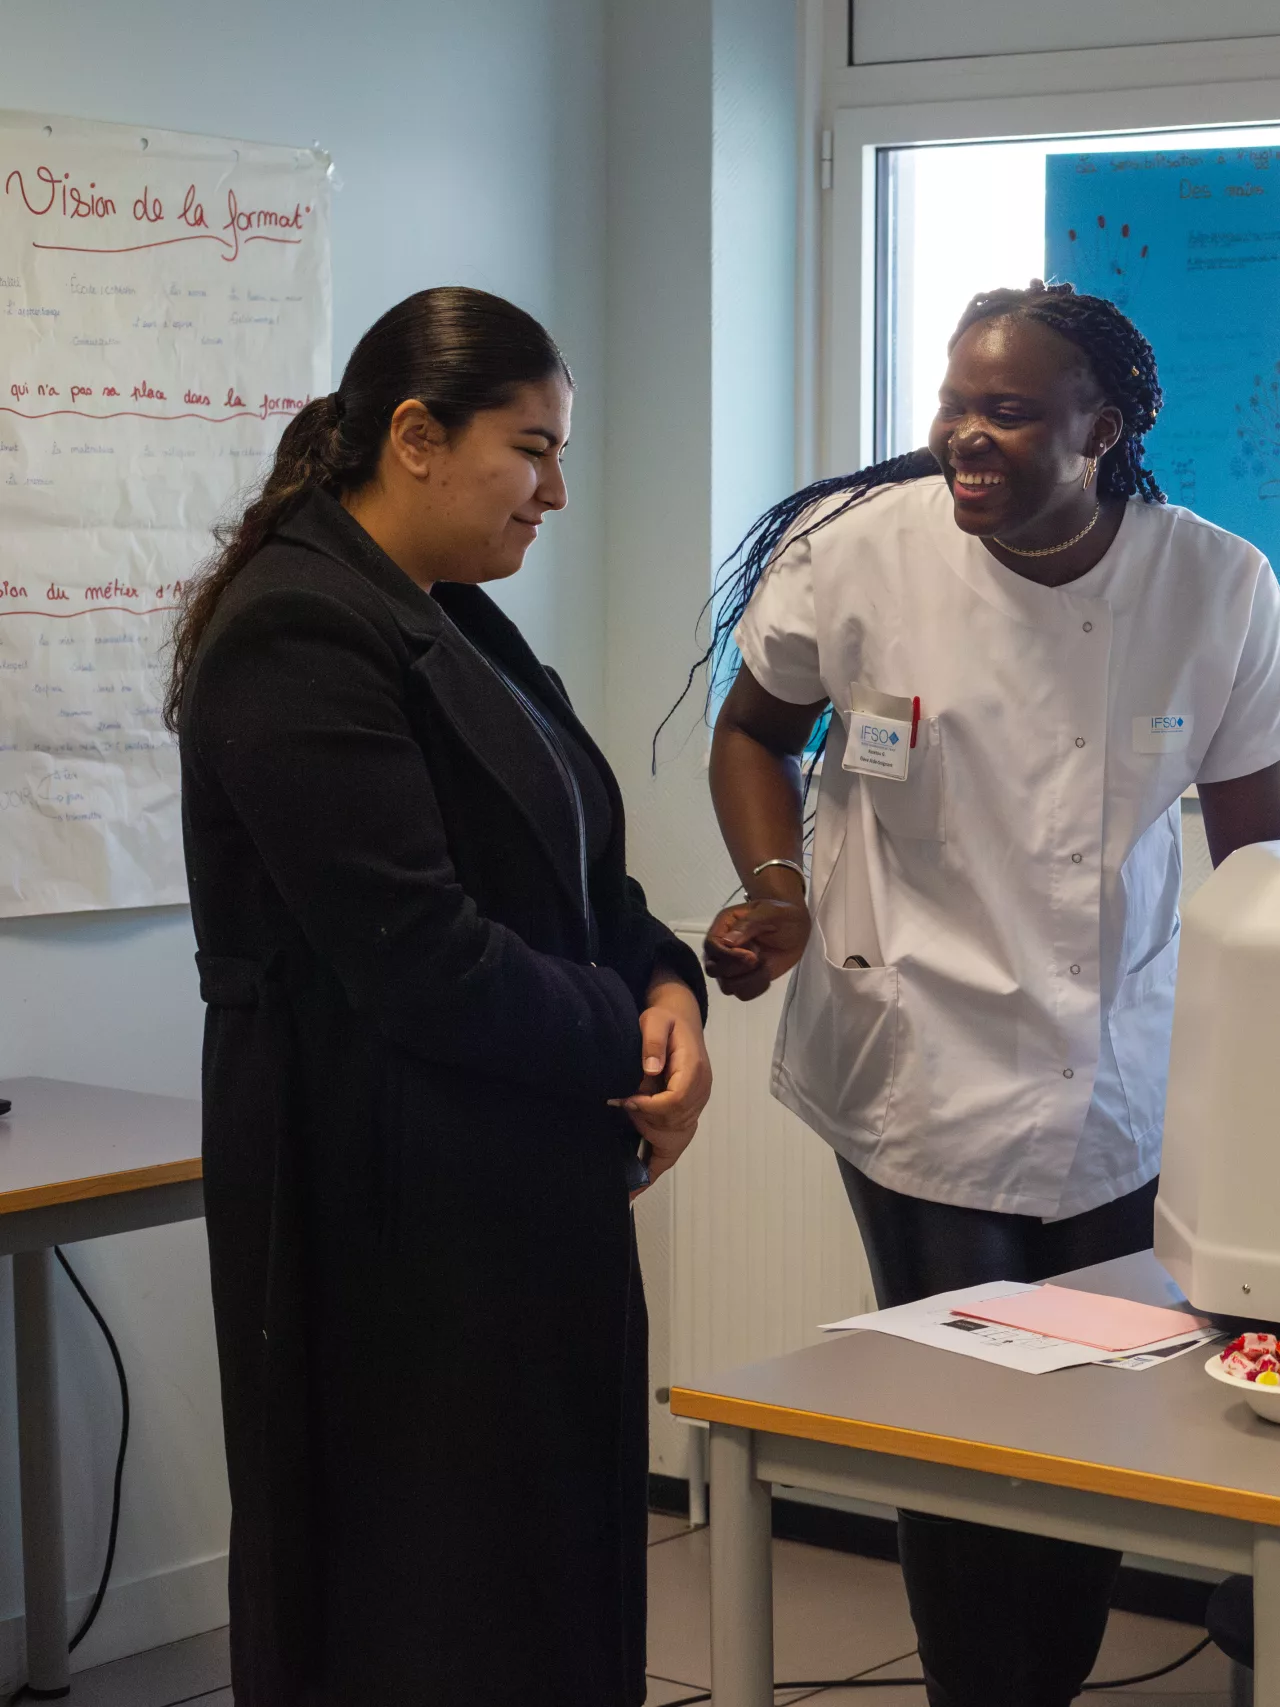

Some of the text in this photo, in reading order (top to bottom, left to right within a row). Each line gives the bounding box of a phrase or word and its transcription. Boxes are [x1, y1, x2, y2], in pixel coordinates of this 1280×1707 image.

[5, 165, 117, 219] Vision
[132, 185, 165, 222] de
[176, 184, 210, 229] la
[1179, 178, 1213, 199] Des
[11, 383, 29, 402] qui
[38, 383, 60, 397] n'a
[70, 385, 93, 403] pas
[102, 387, 120, 397] sa
[130, 380, 168, 404] place
[183, 388, 212, 406] dans
[223, 386, 246, 408] la
[46, 582, 70, 601] du
[85, 577, 140, 601] métier
[1151, 716, 1176, 728] IFSO
[861, 724, 889, 745] IFSO
